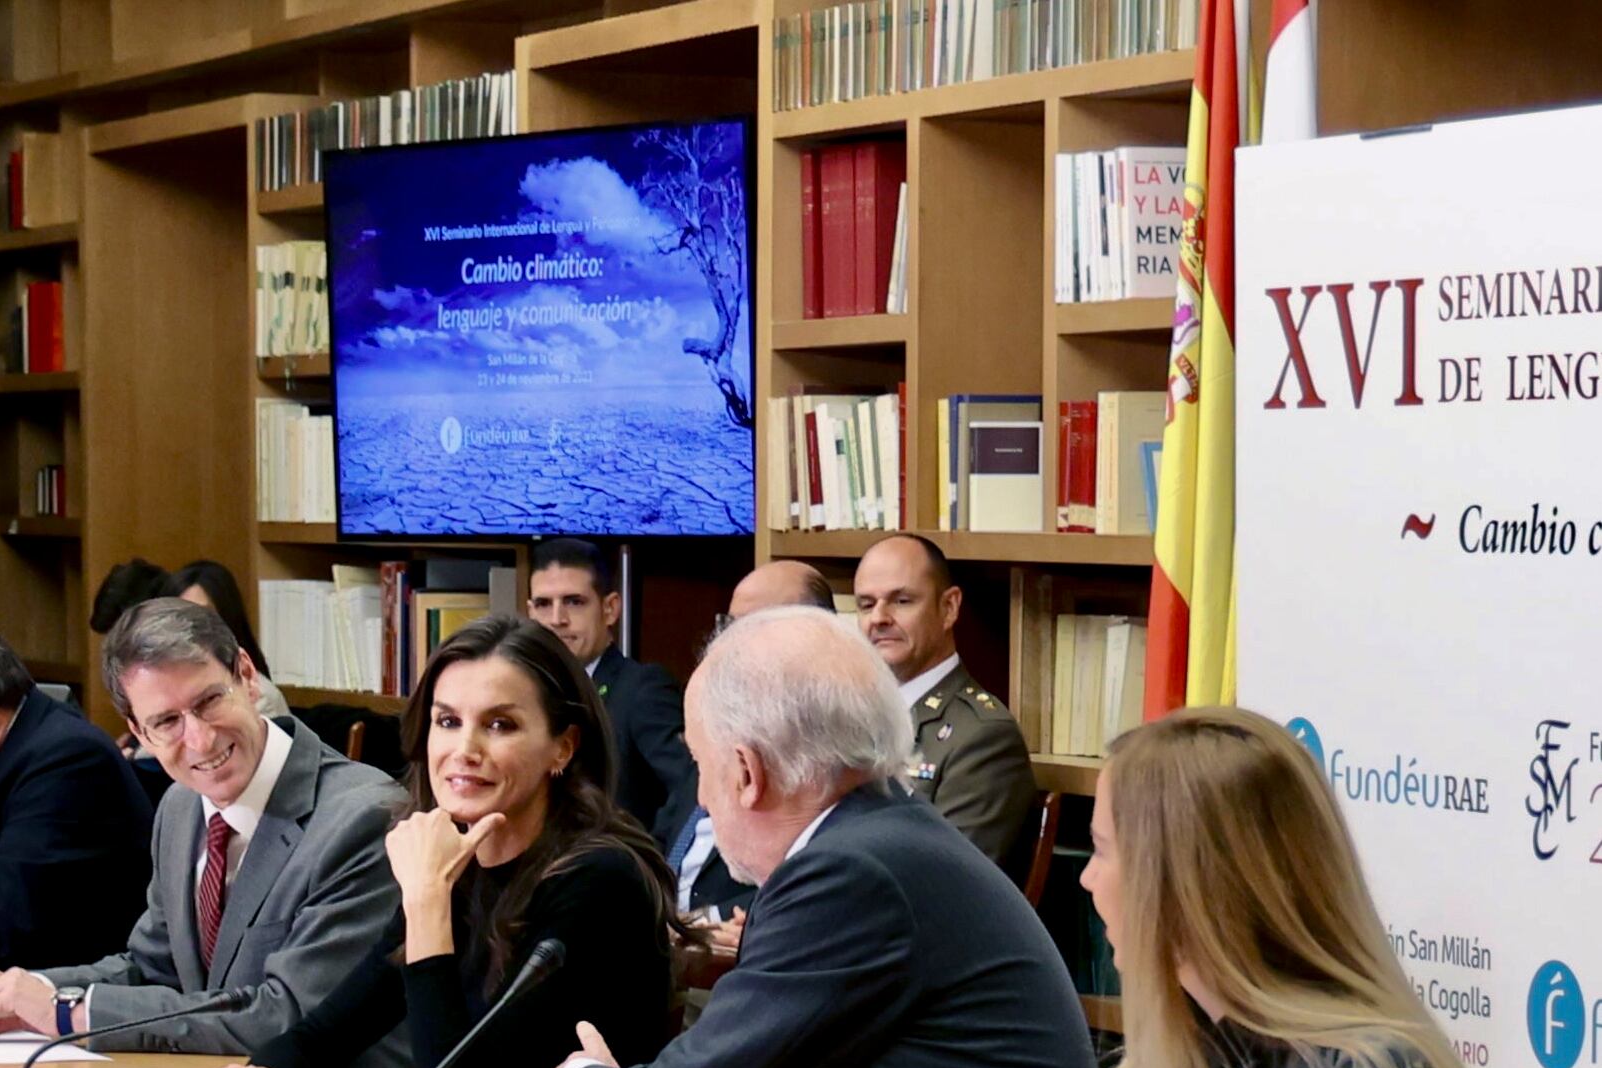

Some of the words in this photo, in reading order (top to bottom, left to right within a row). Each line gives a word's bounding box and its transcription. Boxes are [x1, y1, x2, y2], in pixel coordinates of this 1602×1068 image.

[1134, 165, 1161, 184] LA
[1134, 196, 1146, 214] Y
[1155, 197, 1182, 215] LA
[424, 226, 441, 242] XVI
[442, 223, 483, 241] Seminario
[484, 220, 538, 238] Internacional
[540, 219, 551, 234] de
[552, 217, 583, 235] Lengua
[461, 255, 523, 285] Cambio
[525, 251, 604, 281] climático:
[1137, 256, 1173, 274] RIA
[437, 302, 502, 332] lenguaje
[505, 307, 519, 331] y
[519, 295, 632, 325] comunicación
[1264, 277, 1425, 410] XVI
[1438, 357, 1484, 403] DE
[1459, 502, 1576, 556] Cambio
[1408, 929, 1438, 963] San
[1441, 934, 1492, 971] Millán
[1429, 979, 1492, 1021] Cogolla
